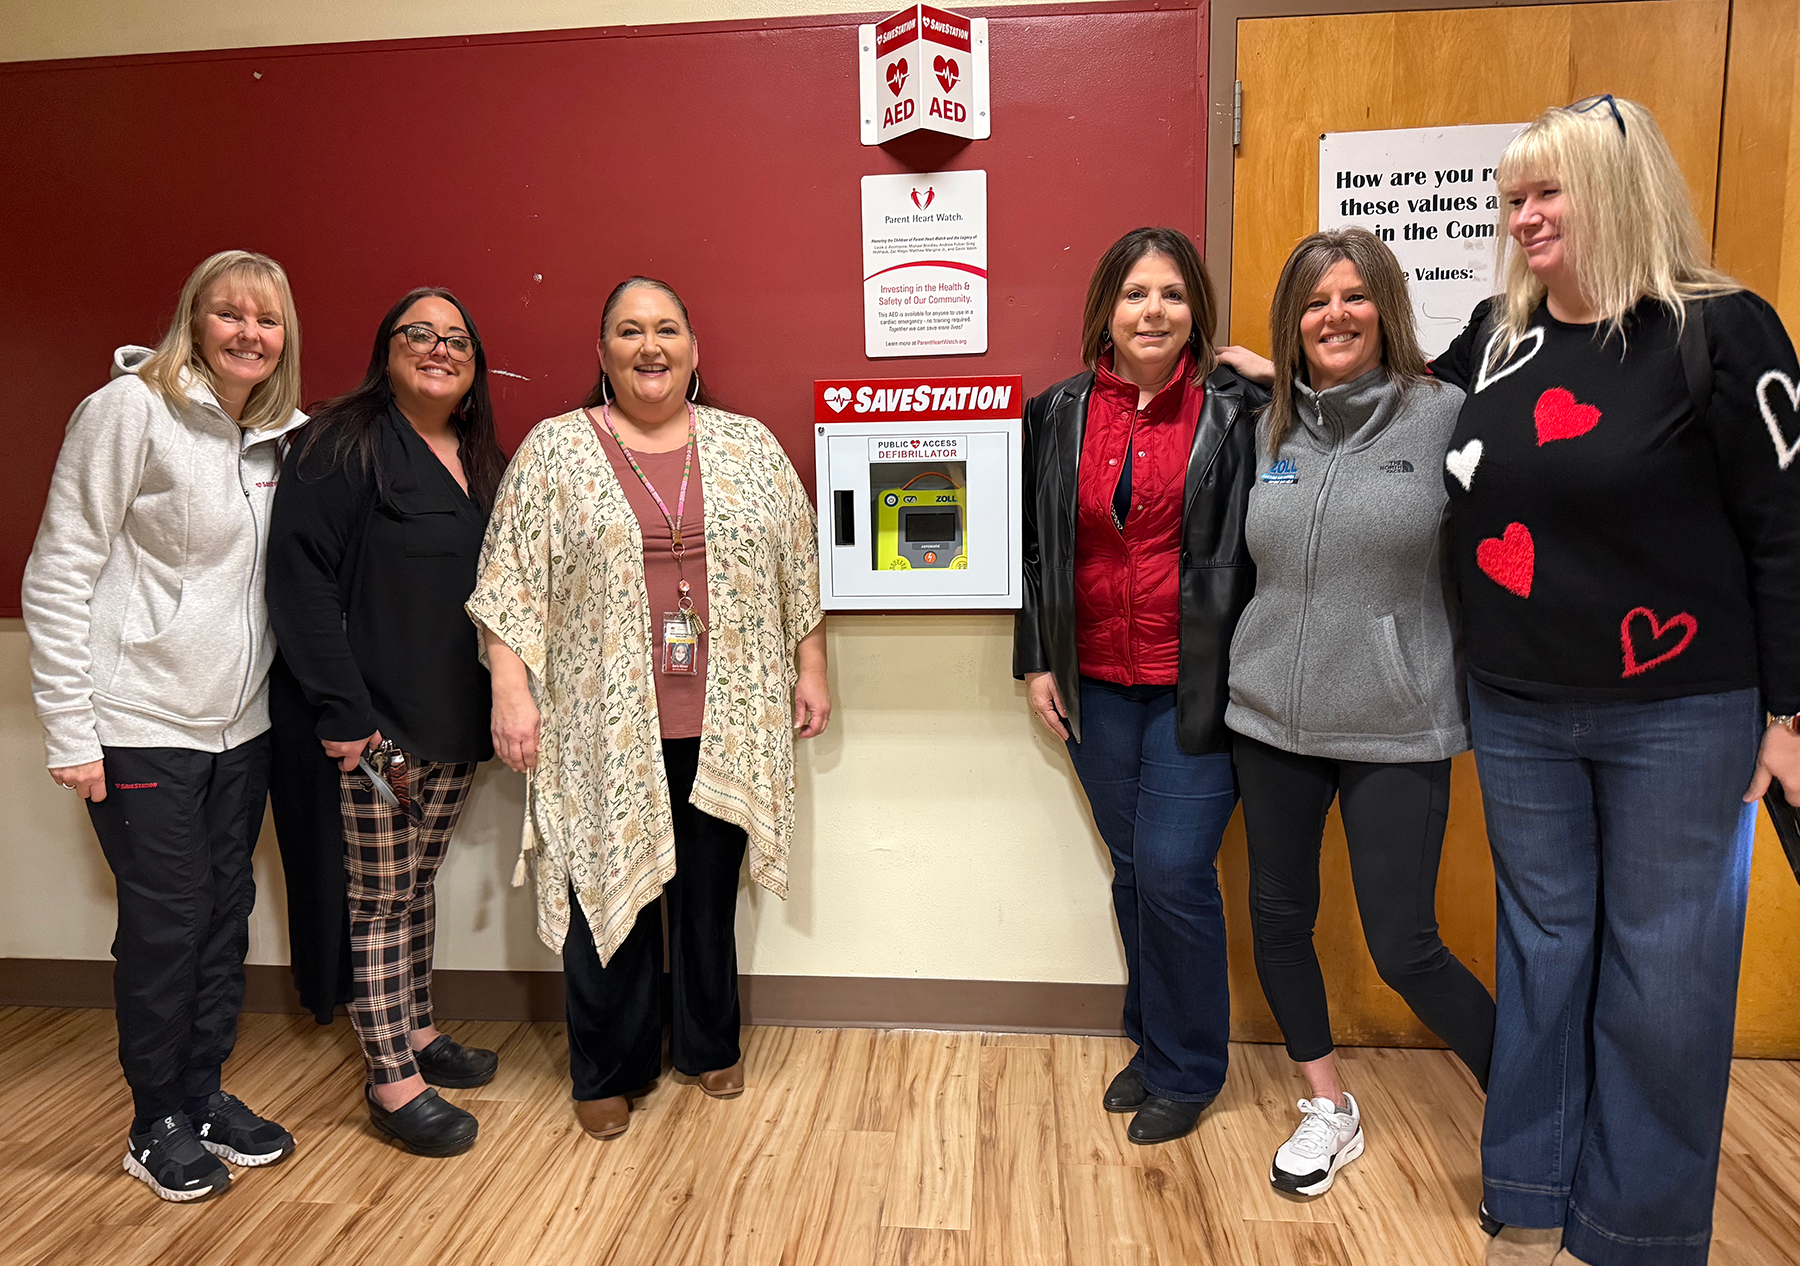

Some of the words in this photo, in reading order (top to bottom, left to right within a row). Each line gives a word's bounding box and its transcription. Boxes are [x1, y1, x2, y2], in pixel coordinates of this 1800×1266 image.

[930, 19, 968, 40] SAVESTATION
[883, 98, 915, 128] AED
[929, 97, 966, 122] AED
[1336, 171, 1382, 189] How
[1390, 172, 1426, 186] are
[1435, 168, 1473, 188] you
[1340, 199, 1399, 216] these
[1408, 194, 1477, 213] values
[913, 214, 933, 222] Heart
[1375, 224, 1395, 241] in
[1403, 223, 1438, 240] the
[1447, 220, 1497, 238] Com
[1415, 268, 1473, 282] Values:
[881, 284, 913, 294] Investing
[939, 283, 962, 291] Health
[964, 282, 970, 290] &
[879, 296, 902, 306] Safety
[904, 296, 911, 305] of
[914, 296, 926, 304] Our
[929, 294, 972, 304] Community.
[854, 385, 1011, 413] SAVESTATION
[878, 449, 957, 458] DEFIBRILLATOR
[1270, 458, 1297, 473] ZOLL
